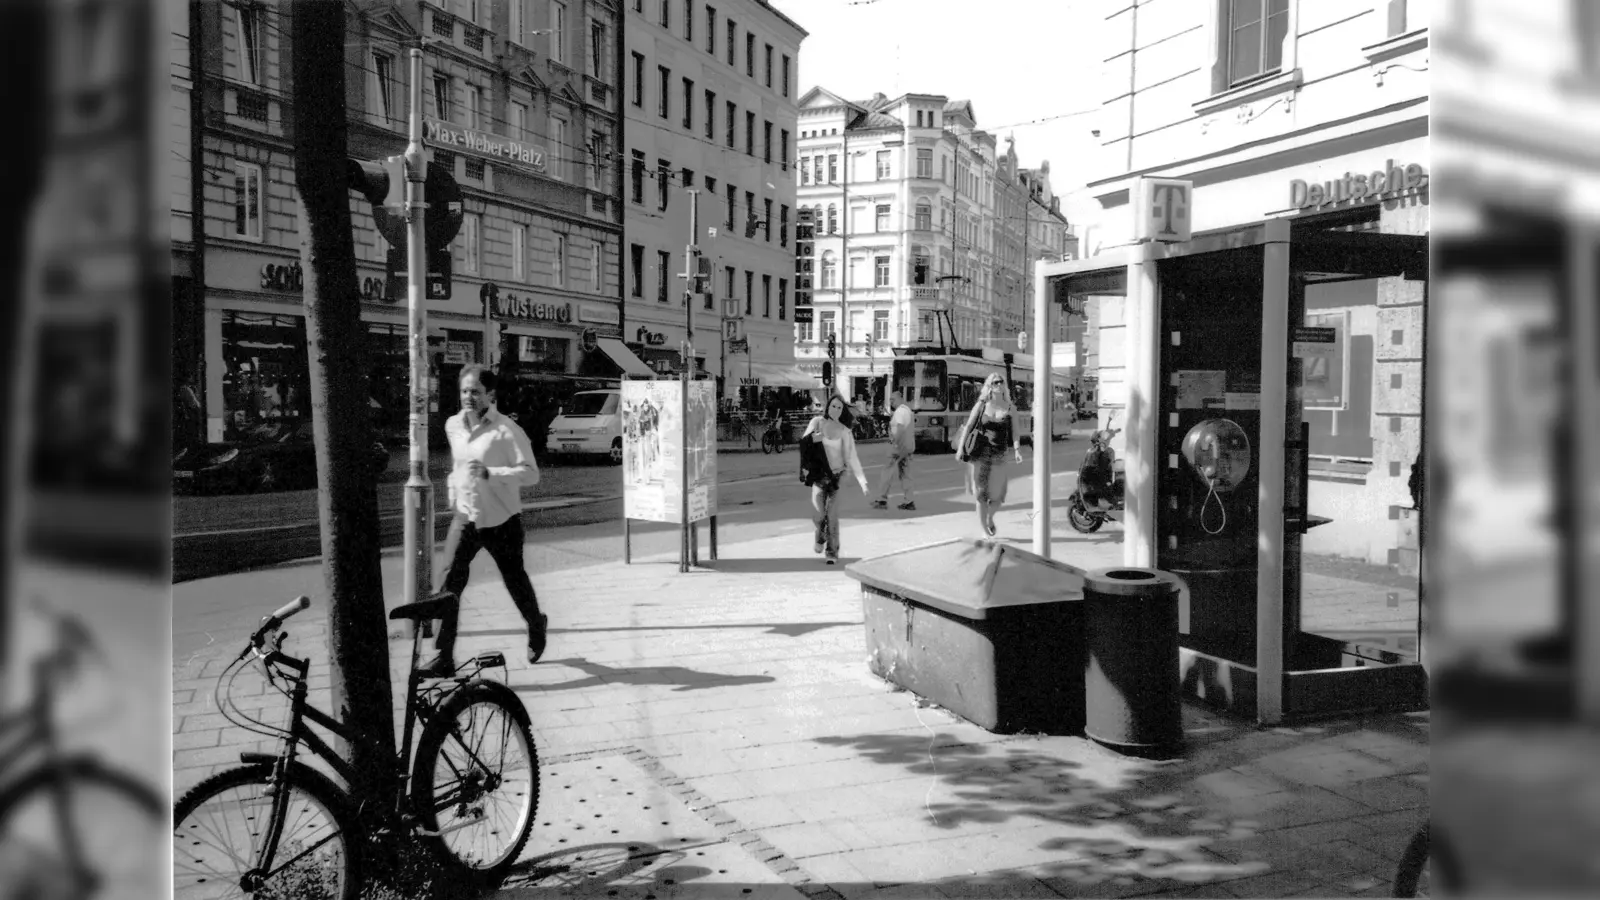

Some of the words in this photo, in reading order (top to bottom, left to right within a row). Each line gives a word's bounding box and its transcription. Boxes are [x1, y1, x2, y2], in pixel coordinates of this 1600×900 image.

[426, 120, 542, 166] Max-Weber-Platz
[1290, 158, 1423, 209] Deutsche
[1153, 184, 1186, 235] T
[802, 225, 813, 305] Kodak
[725, 300, 738, 317] U
